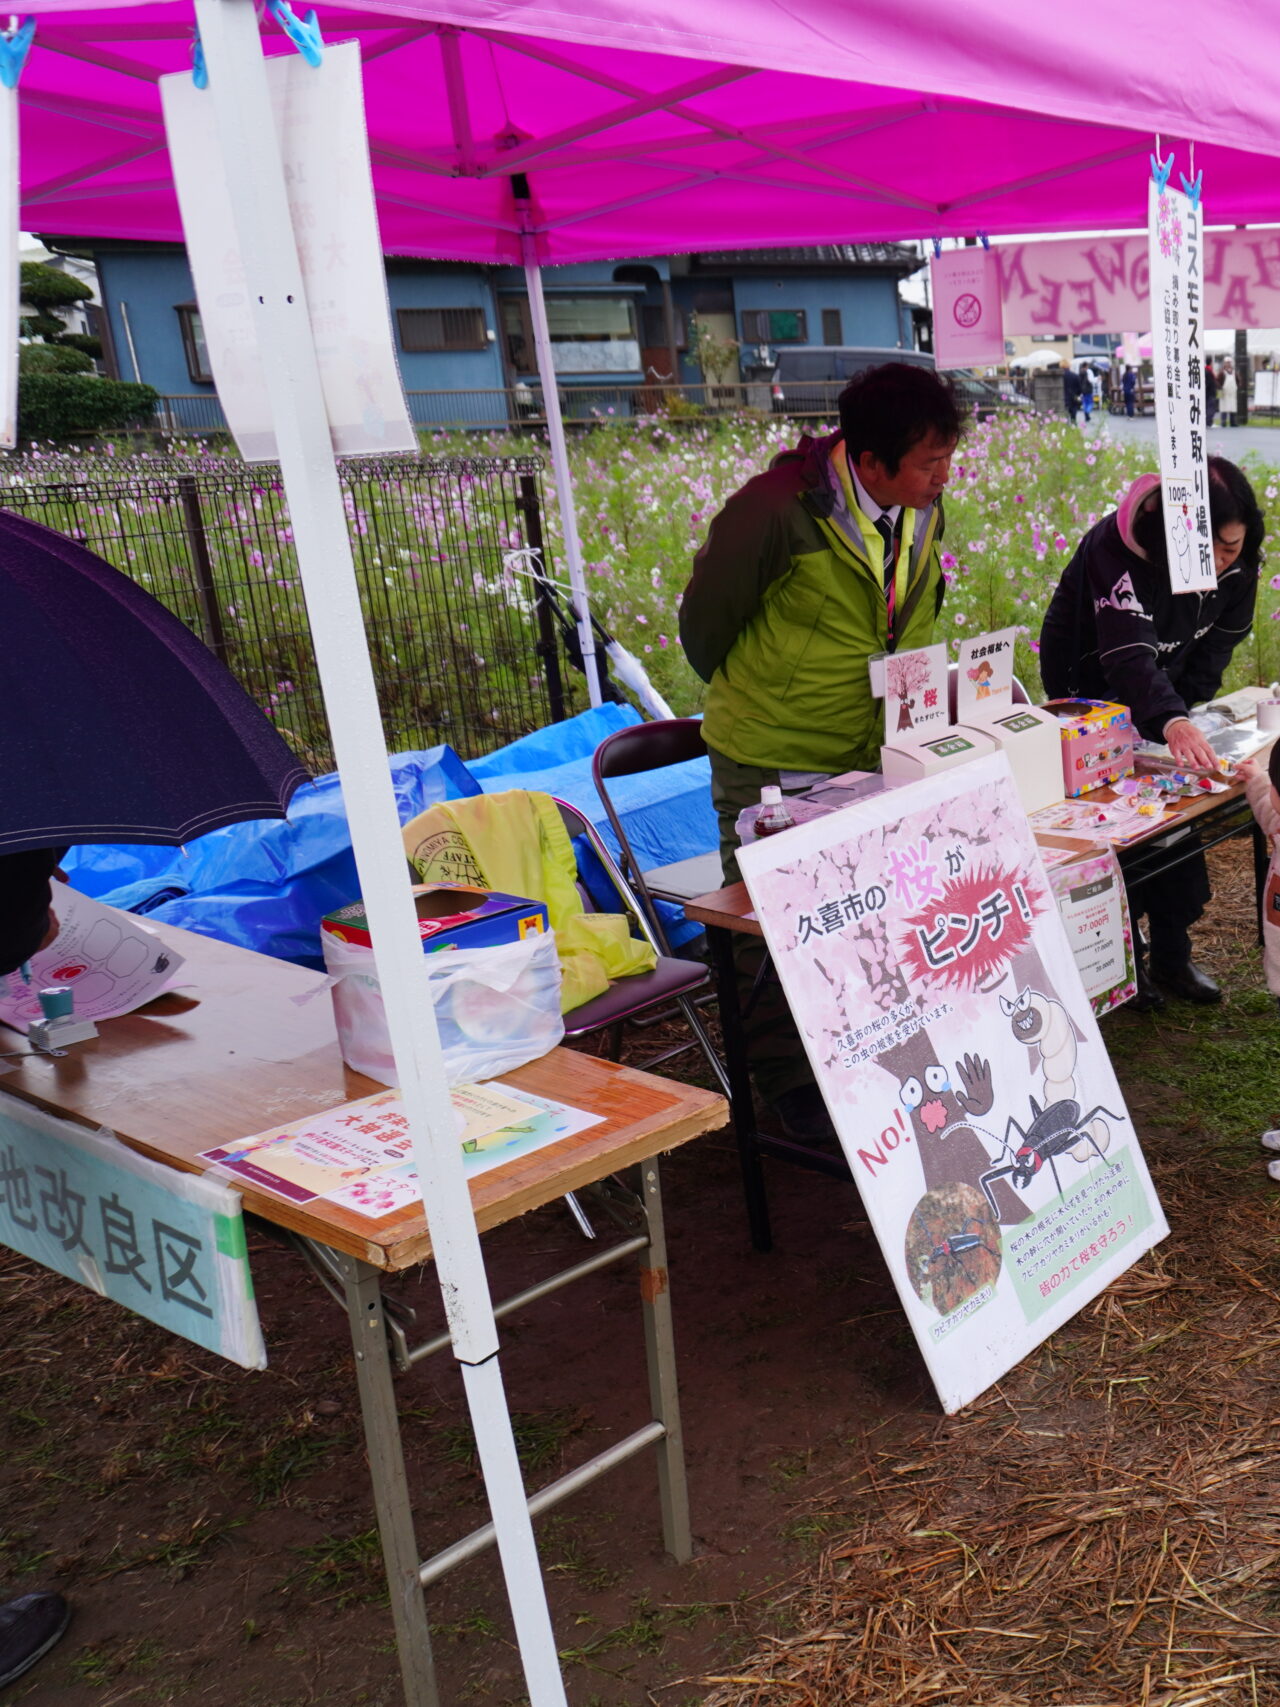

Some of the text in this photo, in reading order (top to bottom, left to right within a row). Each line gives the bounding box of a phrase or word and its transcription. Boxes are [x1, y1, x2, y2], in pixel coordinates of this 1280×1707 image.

[1187, 212, 1212, 576] コスモス摘み取り場所
[971, 641, 1010, 661] 社会福祉へ
[923, 688, 937, 708] 桜
[918, 886, 1030, 966] ピンチ！
[837, 1001, 914, 1051] 久喜市の桜の多くが
[843, 1004, 954, 1068] この虫の被害を受けています。
[857, 1108, 911, 1177] NO!
[1039, 1215, 1134, 1298] 皆の力で桜を守ろう！
[934, 1287, 992, 1337] クビアカツヤカミキリ
